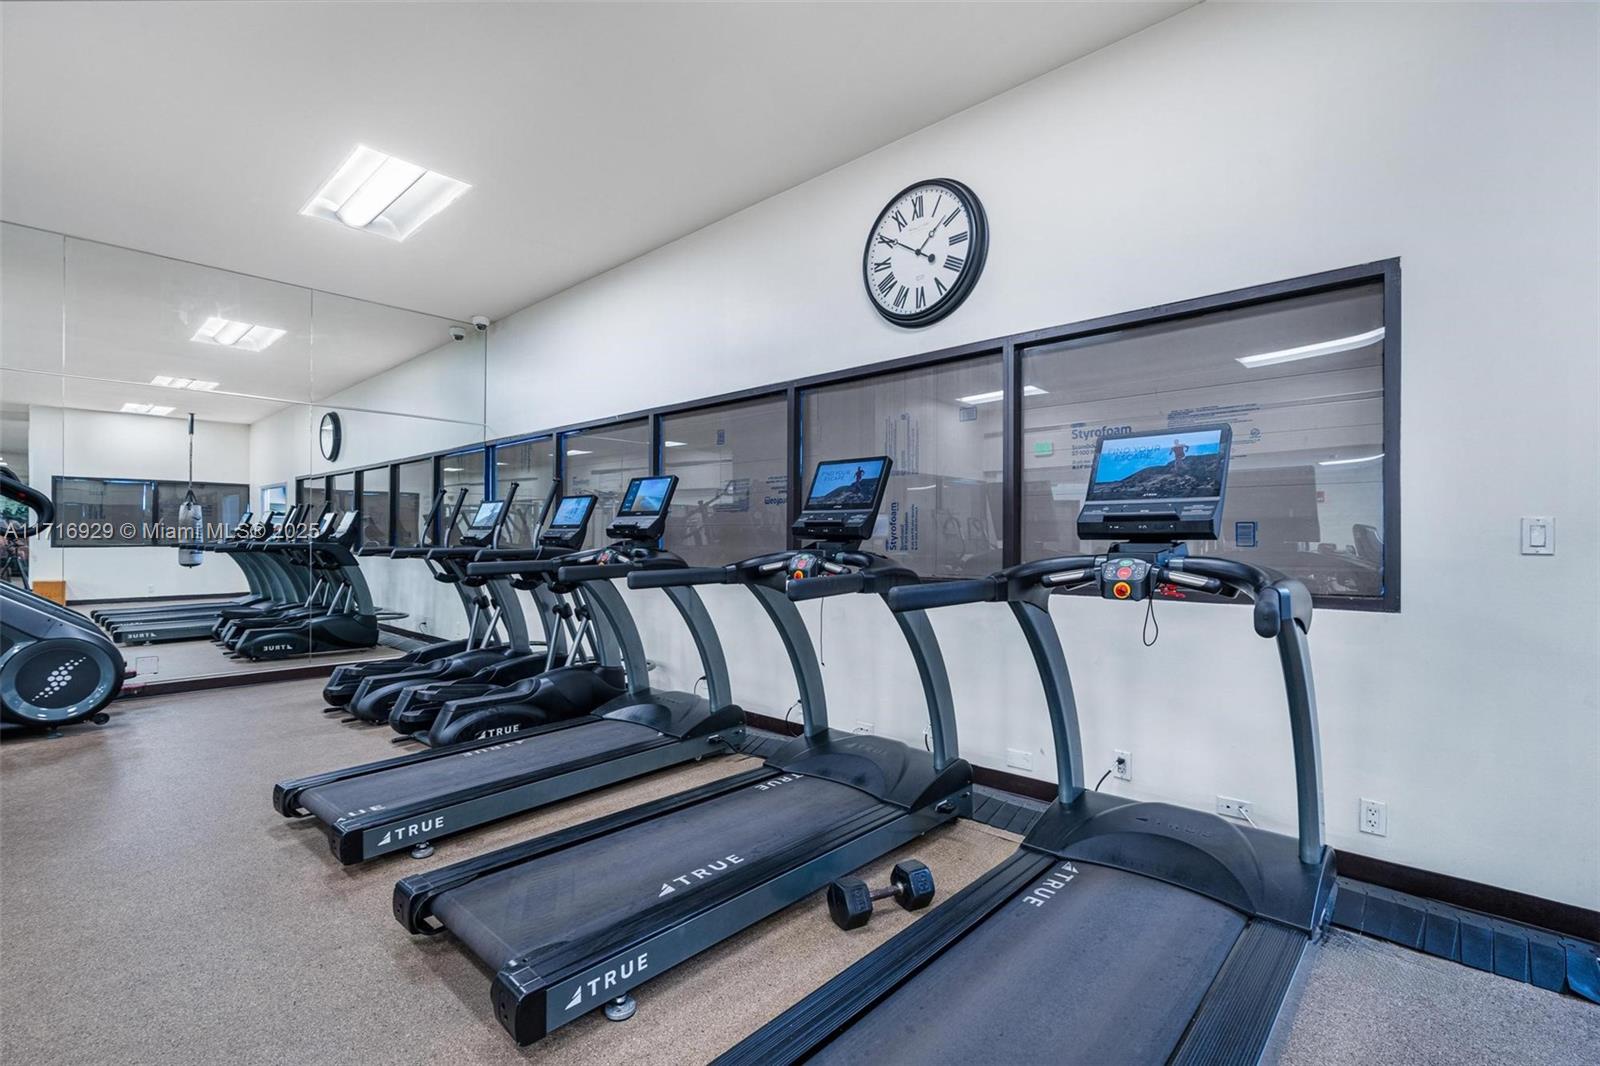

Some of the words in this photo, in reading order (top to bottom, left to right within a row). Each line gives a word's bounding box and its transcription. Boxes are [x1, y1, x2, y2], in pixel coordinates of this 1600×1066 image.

[1071, 425, 1132, 442] Styrofoam
[889, 502, 899, 551] Styrofoam
[488, 724, 520, 738] TRUE
[754, 773, 804, 791] TRUE
[394, 815, 446, 841] TRUE
[673, 852, 745, 887] TRUE
[1022, 871, 1074, 908] TRUE
[586, 952, 650, 998] TRUE
